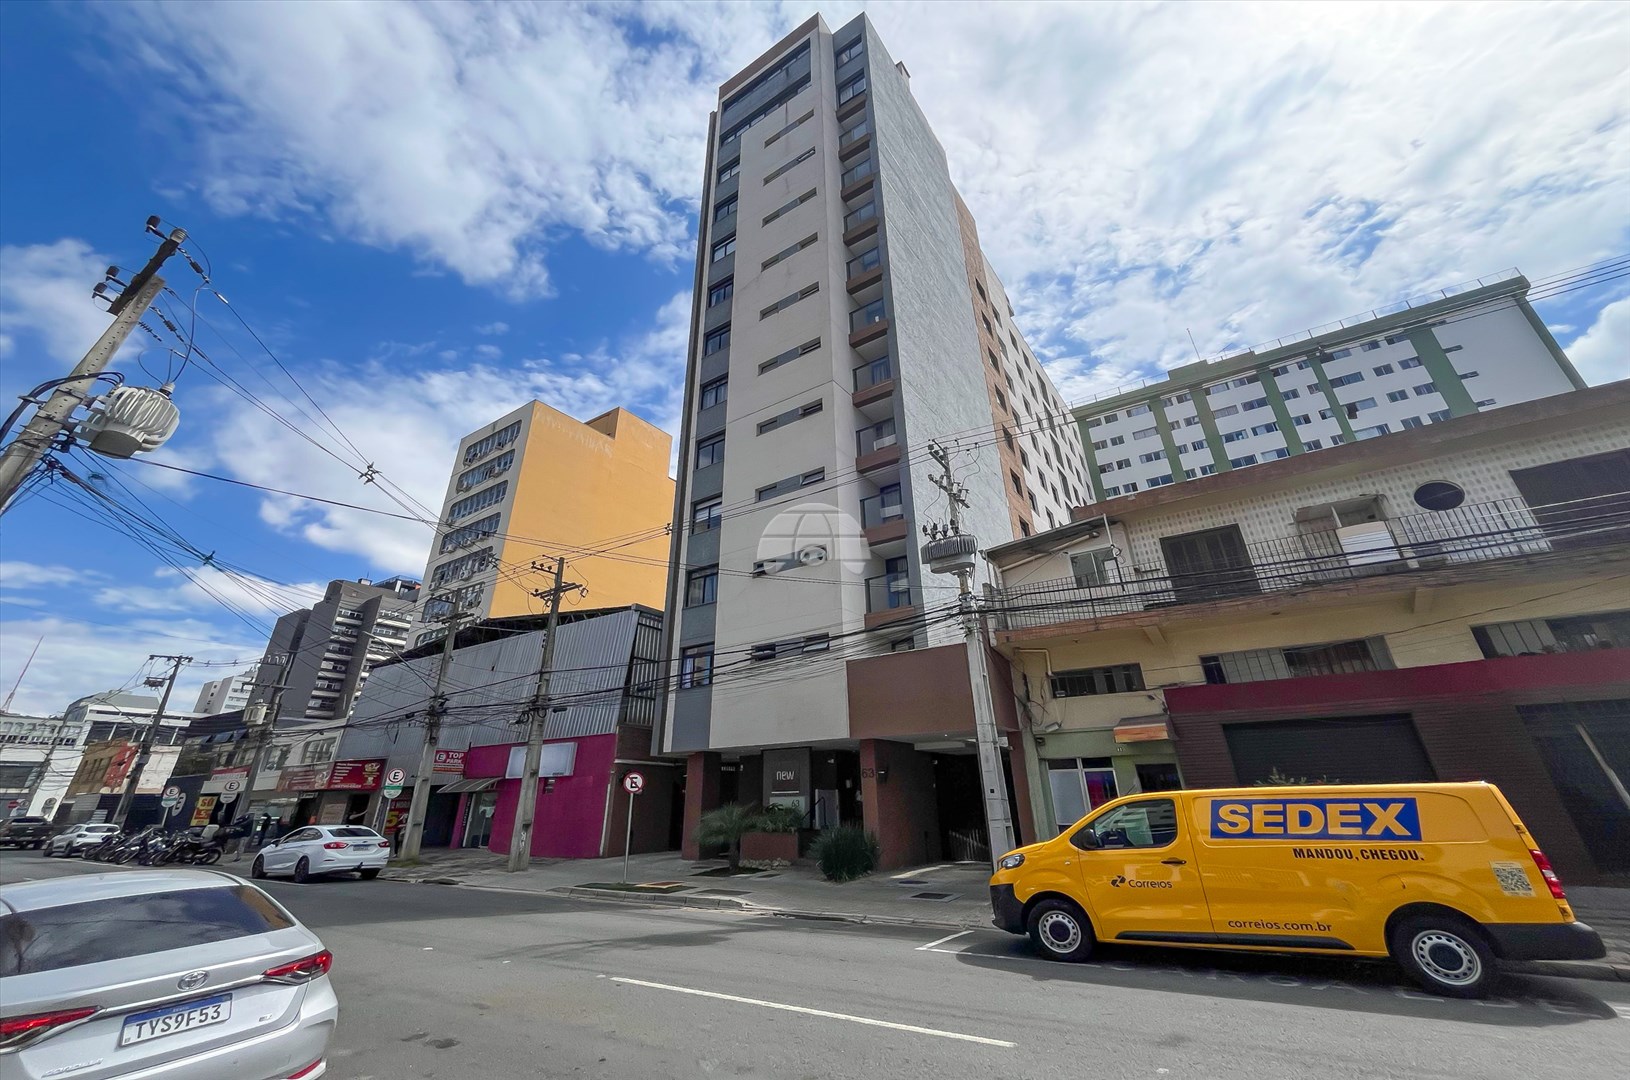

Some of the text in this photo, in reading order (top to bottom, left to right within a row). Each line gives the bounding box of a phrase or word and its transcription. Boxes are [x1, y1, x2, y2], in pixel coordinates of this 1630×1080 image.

[392, 771, 400, 780] E
[776, 771, 795, 781] new
[862, 768, 875, 778] 63
[229, 782, 236, 790] E
[791, 800, 800, 808] 63
[1217, 803, 1412, 836] SEDEX
[1293, 848, 1425, 861] MANDOU, CHEGOU.
[1128, 879, 1172, 889] Correios
[1228, 919, 1332, 932] correios.com.br
[136, 1004, 221, 1039] TYS9F53
